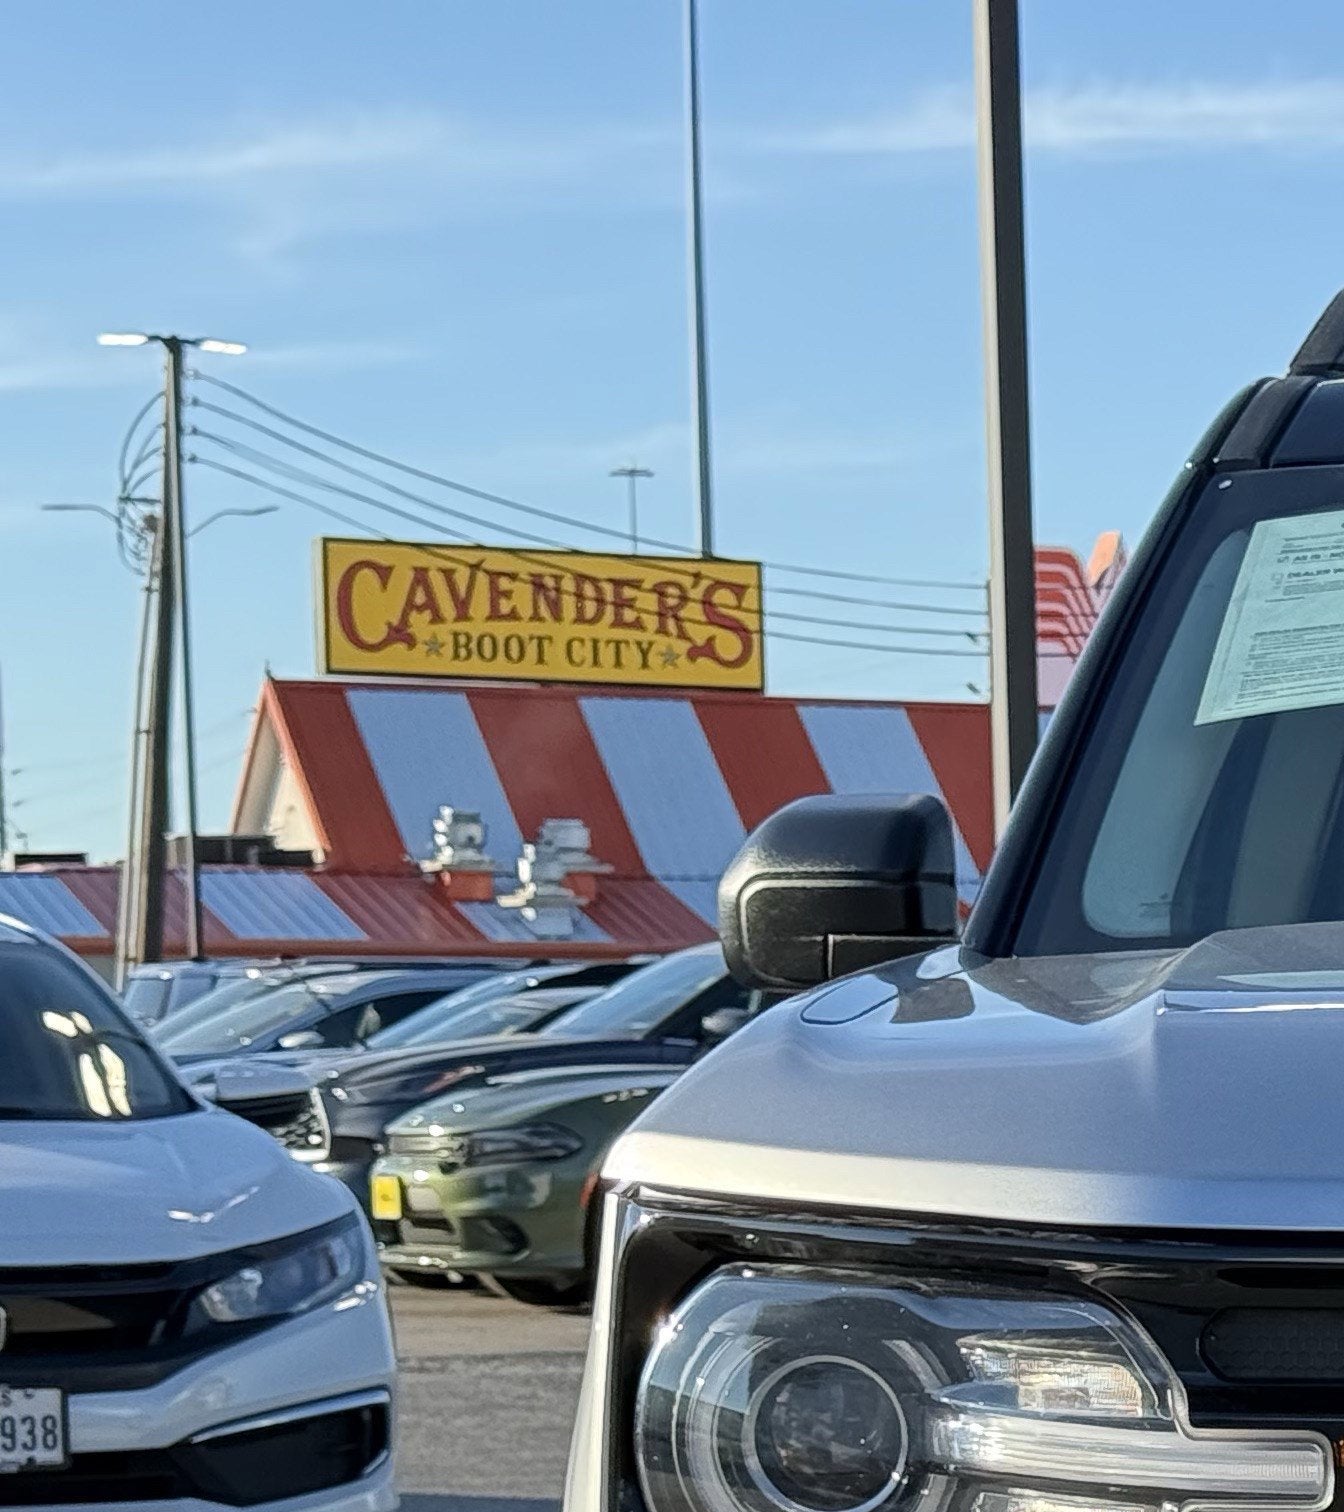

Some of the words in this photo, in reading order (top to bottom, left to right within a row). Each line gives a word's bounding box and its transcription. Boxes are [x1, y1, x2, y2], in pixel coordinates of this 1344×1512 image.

[337, 558, 753, 669] CAVENDER'S
[451, 631, 553, 665] BOOT
[565, 638, 657, 671] CITY
